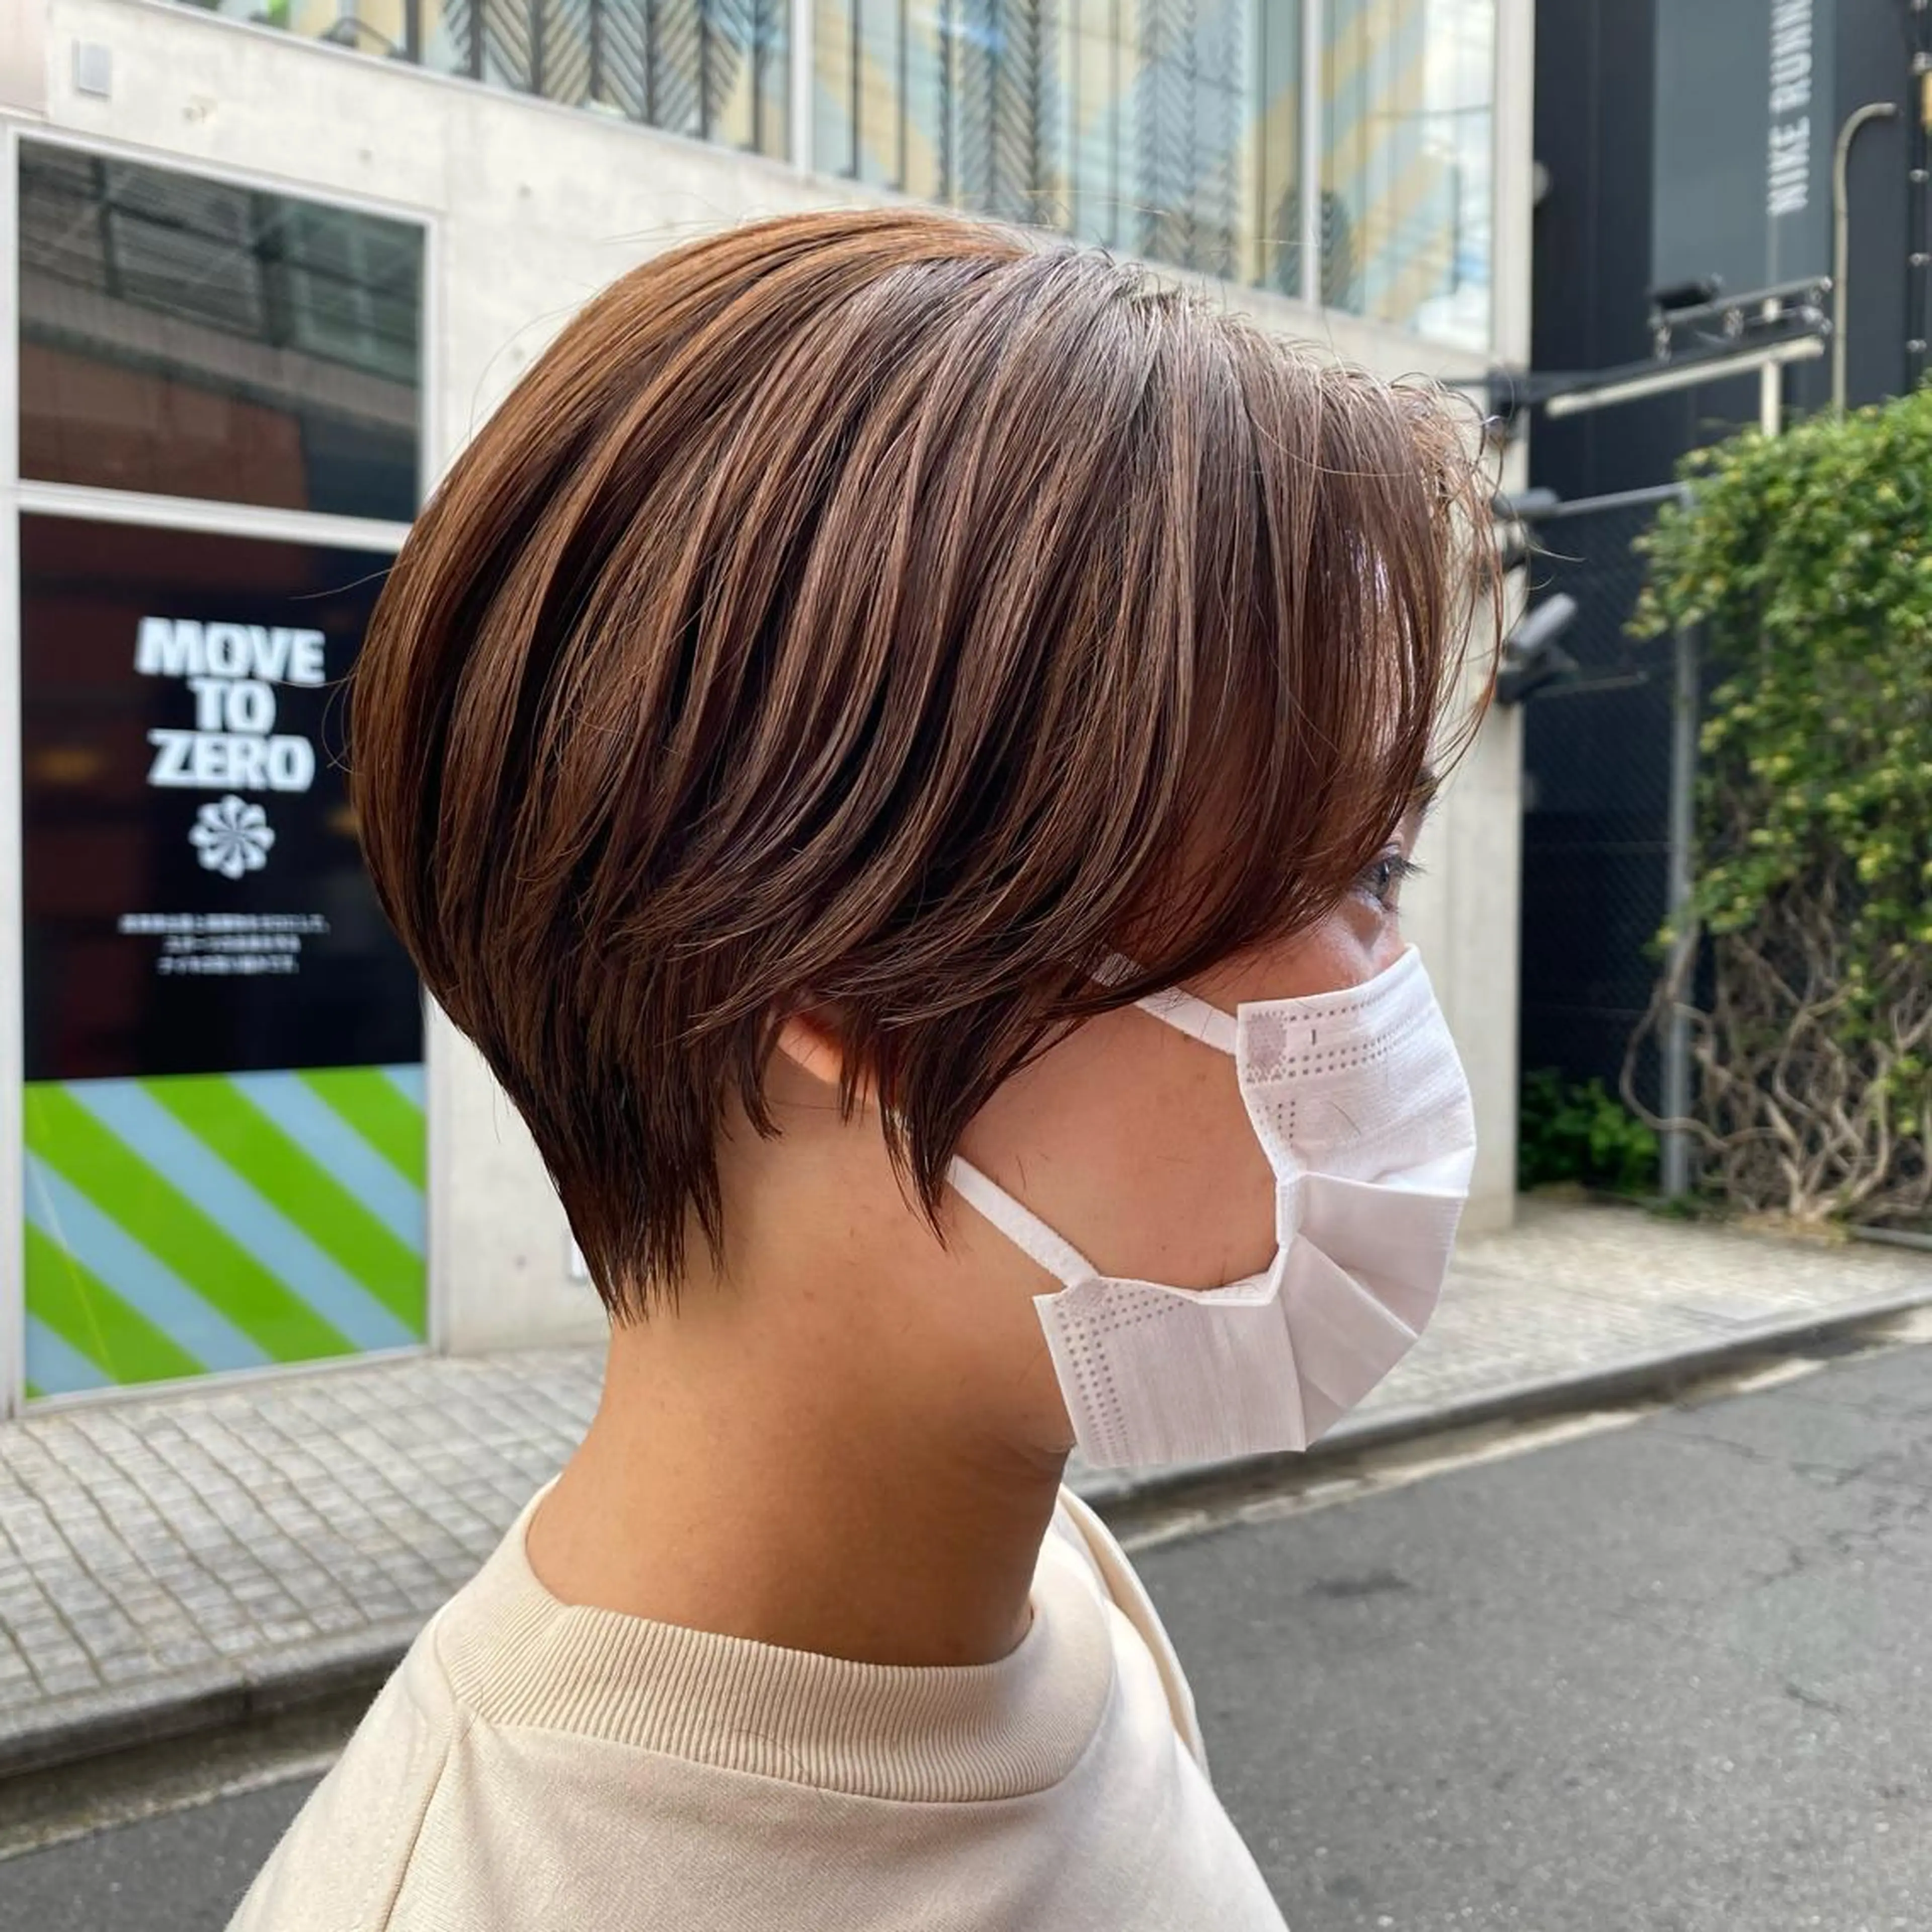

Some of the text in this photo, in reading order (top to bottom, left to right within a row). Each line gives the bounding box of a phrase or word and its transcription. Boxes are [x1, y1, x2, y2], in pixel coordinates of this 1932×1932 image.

[1767, 116, 1810, 215] NIKE
[135, 616, 325, 686] MOVE
[187, 677, 276, 734] TO
[147, 729, 314, 791] ZERO
